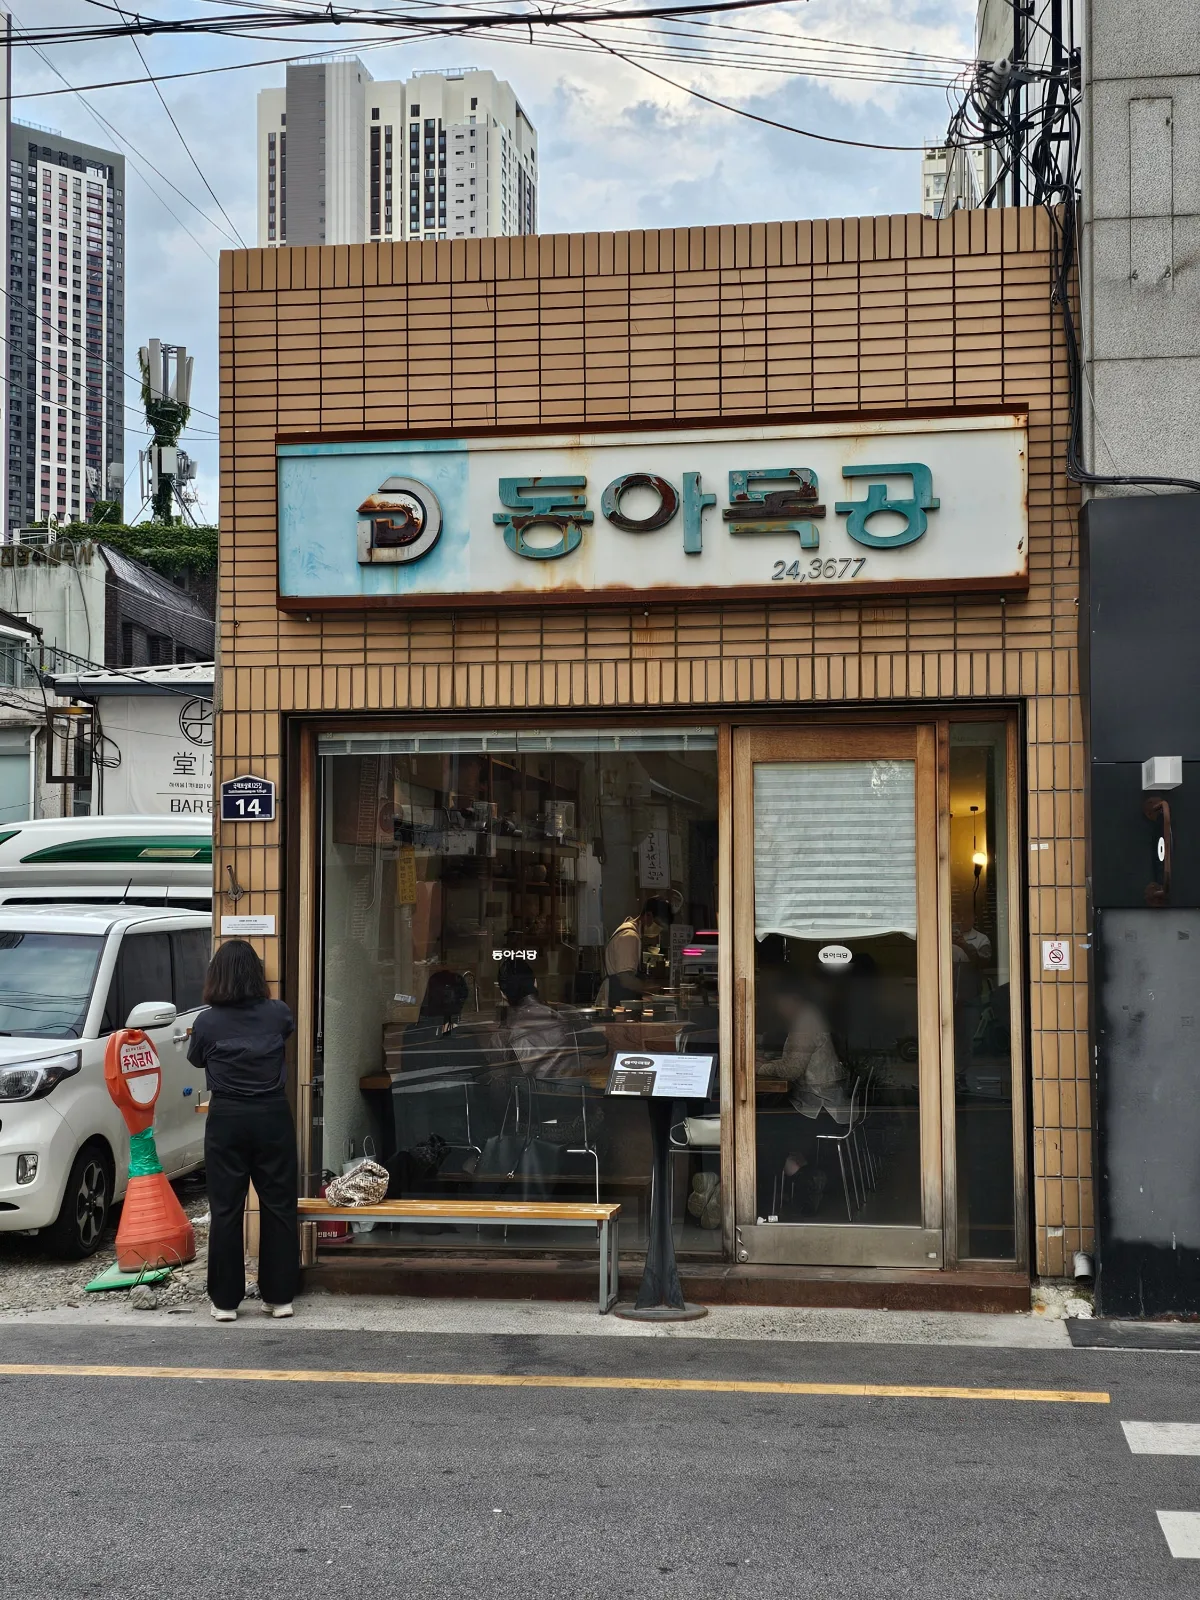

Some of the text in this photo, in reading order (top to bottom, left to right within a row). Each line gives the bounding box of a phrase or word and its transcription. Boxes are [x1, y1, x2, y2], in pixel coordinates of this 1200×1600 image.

[493, 462, 941, 561] 동아목공
[771, 557, 867, 582] 24,3677
[173, 751, 197, 775] 堂
[235, 798, 262, 815] 14
[492, 950, 538, 960] 동아식당
[122, 1050, 154, 1071] 주차금지
